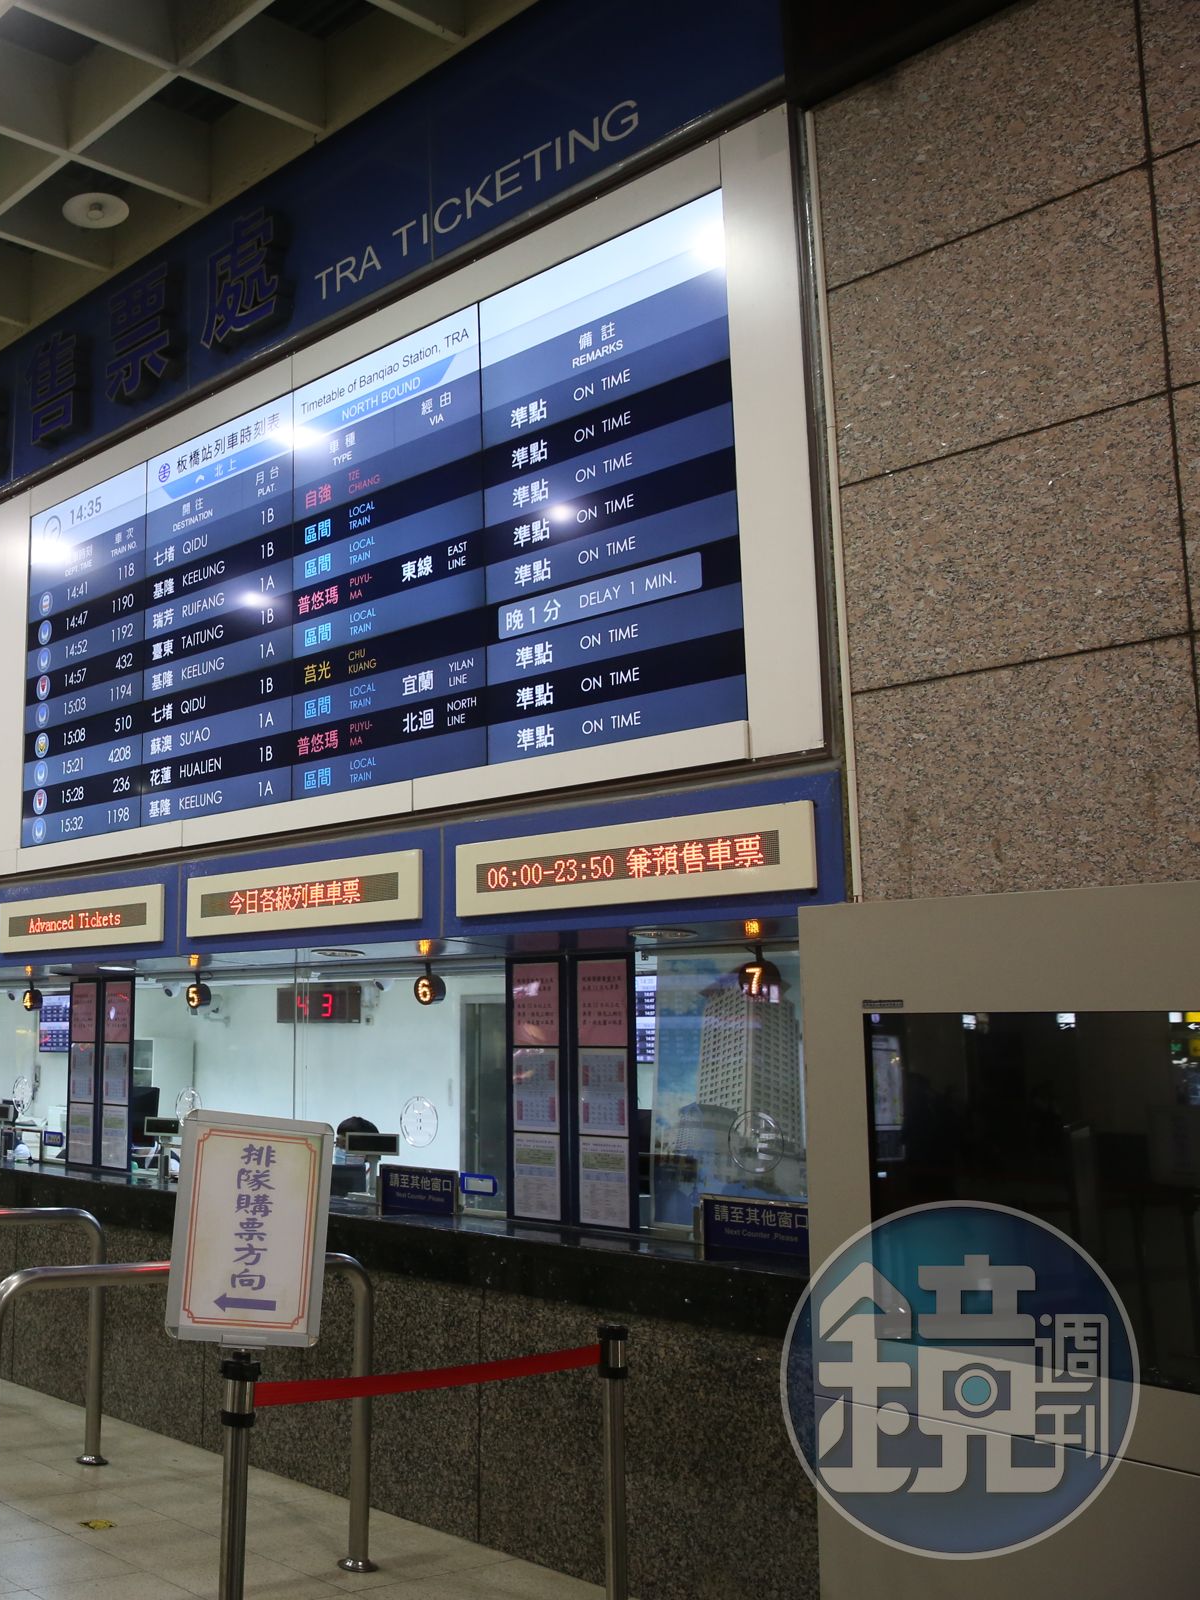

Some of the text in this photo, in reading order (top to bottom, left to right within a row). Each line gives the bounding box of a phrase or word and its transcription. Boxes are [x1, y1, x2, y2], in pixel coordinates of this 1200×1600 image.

[315, 100, 639, 300] TRA TICKETING
[579, 322, 615, 350] 備註
[572, 340, 623, 368] REMARKS
[301, 328, 469, 415] Timetable of Banqiao Station, TRA
[342, 377, 421, 421] NORTH BOUND
[421, 391, 452, 416] 經由
[511, 368, 631, 429] 準點 ON TIME
[429, 413, 444, 426] VIA
[176, 412, 280, 474] 板橋站列車時刻表
[512, 411, 631, 469] 準點 ON TIME
[332, 451, 352, 466] TYPE
[214, 459, 237, 478] 北上
[256, 466, 279, 486] 月台
[349, 470, 360, 481] TZE
[349, 474, 380, 494] CHIANG
[513, 452, 632, 508] 準點 ON TIME
[258, 484, 276, 498] PLAT.
[305, 484, 331, 510] 自強
[70, 496, 102, 524] 14:35
[261, 508, 274, 525] 1B
[349, 501, 375, 517] LOCAL
[173, 509, 213, 532] DESTINATION
[349, 516, 370, 530] TRAIN
[513, 494, 634, 547] 準點 ON TIME
[115, 527, 134, 544] 車次
[305, 519, 331, 545] 區間
[111, 546, 127, 557] TRAIN
[154, 534, 208, 566] 七堵 QIDU
[261, 542, 274, 559] 1B
[448, 542, 467, 557] EAST
[305, 553, 331, 579] 區間
[402, 555, 433, 583] 東線
[448, 557, 466, 570] LINE
[514, 536, 636, 587] 準點 ON TIME
[118, 563, 134, 580] 118
[153, 561, 225, 599] 基隆 KEELUNG
[350, 573, 372, 587] PUYU-
[67, 582, 88, 600] 14:41
[261, 575, 274, 592] 1A
[579, 585, 621, 608] DELAY
[630, 581, 635, 594] 1
[645, 572, 676, 591] MIN.
[112, 594, 134, 613] 1190
[298, 585, 338, 615] 普悠瑪
[350, 590, 362, 600] MA
[66, 611, 88, 630] 14:47
[153, 593, 224, 629] 瑞芳 RUIFANG
[261, 608, 274, 625] 1B
[111, 623, 133, 642] 1192
[305, 623, 331, 647] 區間
[65, 640, 88, 658] 14:52
[152, 625, 224, 660] 臺東 TAITUNG
[260, 642, 274, 659] 1A
[516, 624, 638, 669] 準點 ON TIME
[116, 653, 132, 670] 432
[348, 649, 365, 661] CHU
[152, 657, 224, 691] 基隆 KEELUNG
[304, 661, 331, 684] 莒光
[349, 659, 376, 674] KUANG
[449, 658, 474, 672] YILAN
[64, 668, 86, 686] 14:57
[260, 678, 273, 694] 1B
[402, 670, 434, 696] 宜蘭
[449, 674, 467, 687] LINE
[110, 683, 132, 701] 1194
[516, 667, 640, 710] 準點 ON TIME
[64, 697, 86, 715] 15:03
[152, 696, 206, 723] 七堵 QIDU
[305, 696, 331, 719] 區間
[447, 697, 477, 712] NORTH
[115, 715, 132, 732] 510
[259, 712, 273, 728] 1A
[402, 709, 434, 733] 北迴
[447, 714, 466, 727] LINE
[63, 728, 85, 746] 15:08
[517, 711, 641, 751] 準點 ON TIME
[150, 727, 210, 755] 蘇澳 SU'AO
[297, 730, 338, 756] 普悠瑪
[108, 746, 131, 763] 4208
[260, 746, 272, 762] 1B
[350, 757, 376, 769] LOCAL
[62, 758, 83, 774] 15:21
[150, 757, 221, 786] 花蓮 HUALIEN
[113, 776, 130, 793] 236
[304, 768, 331, 790] 區間
[350, 771, 371, 783] TRAIN
[61, 786, 83, 804] 15:28
[259, 781, 273, 797] 1A
[149, 791, 222, 818] 基隆 KEELUNG
[61, 816, 83, 832] 15:32
[108, 807, 129, 824] 1198
[487, 835, 764, 890] 06:00-23:50 兼預售車票
[230, 879, 361, 915] 今日各級列車車票
[29, 912, 121, 934] Advanced Tickets
[419, 980, 430, 1001] 6
[746, 968, 762, 994] 7
[23, 993, 32, 1008] 4
[189, 987, 198, 1006] 5
[389, 1172, 452, 1192] 請至其他窗口
[231, 1144, 277, 1290] 排隊購票方向
[714, 1205, 808, 1229] 請至其他窗口
